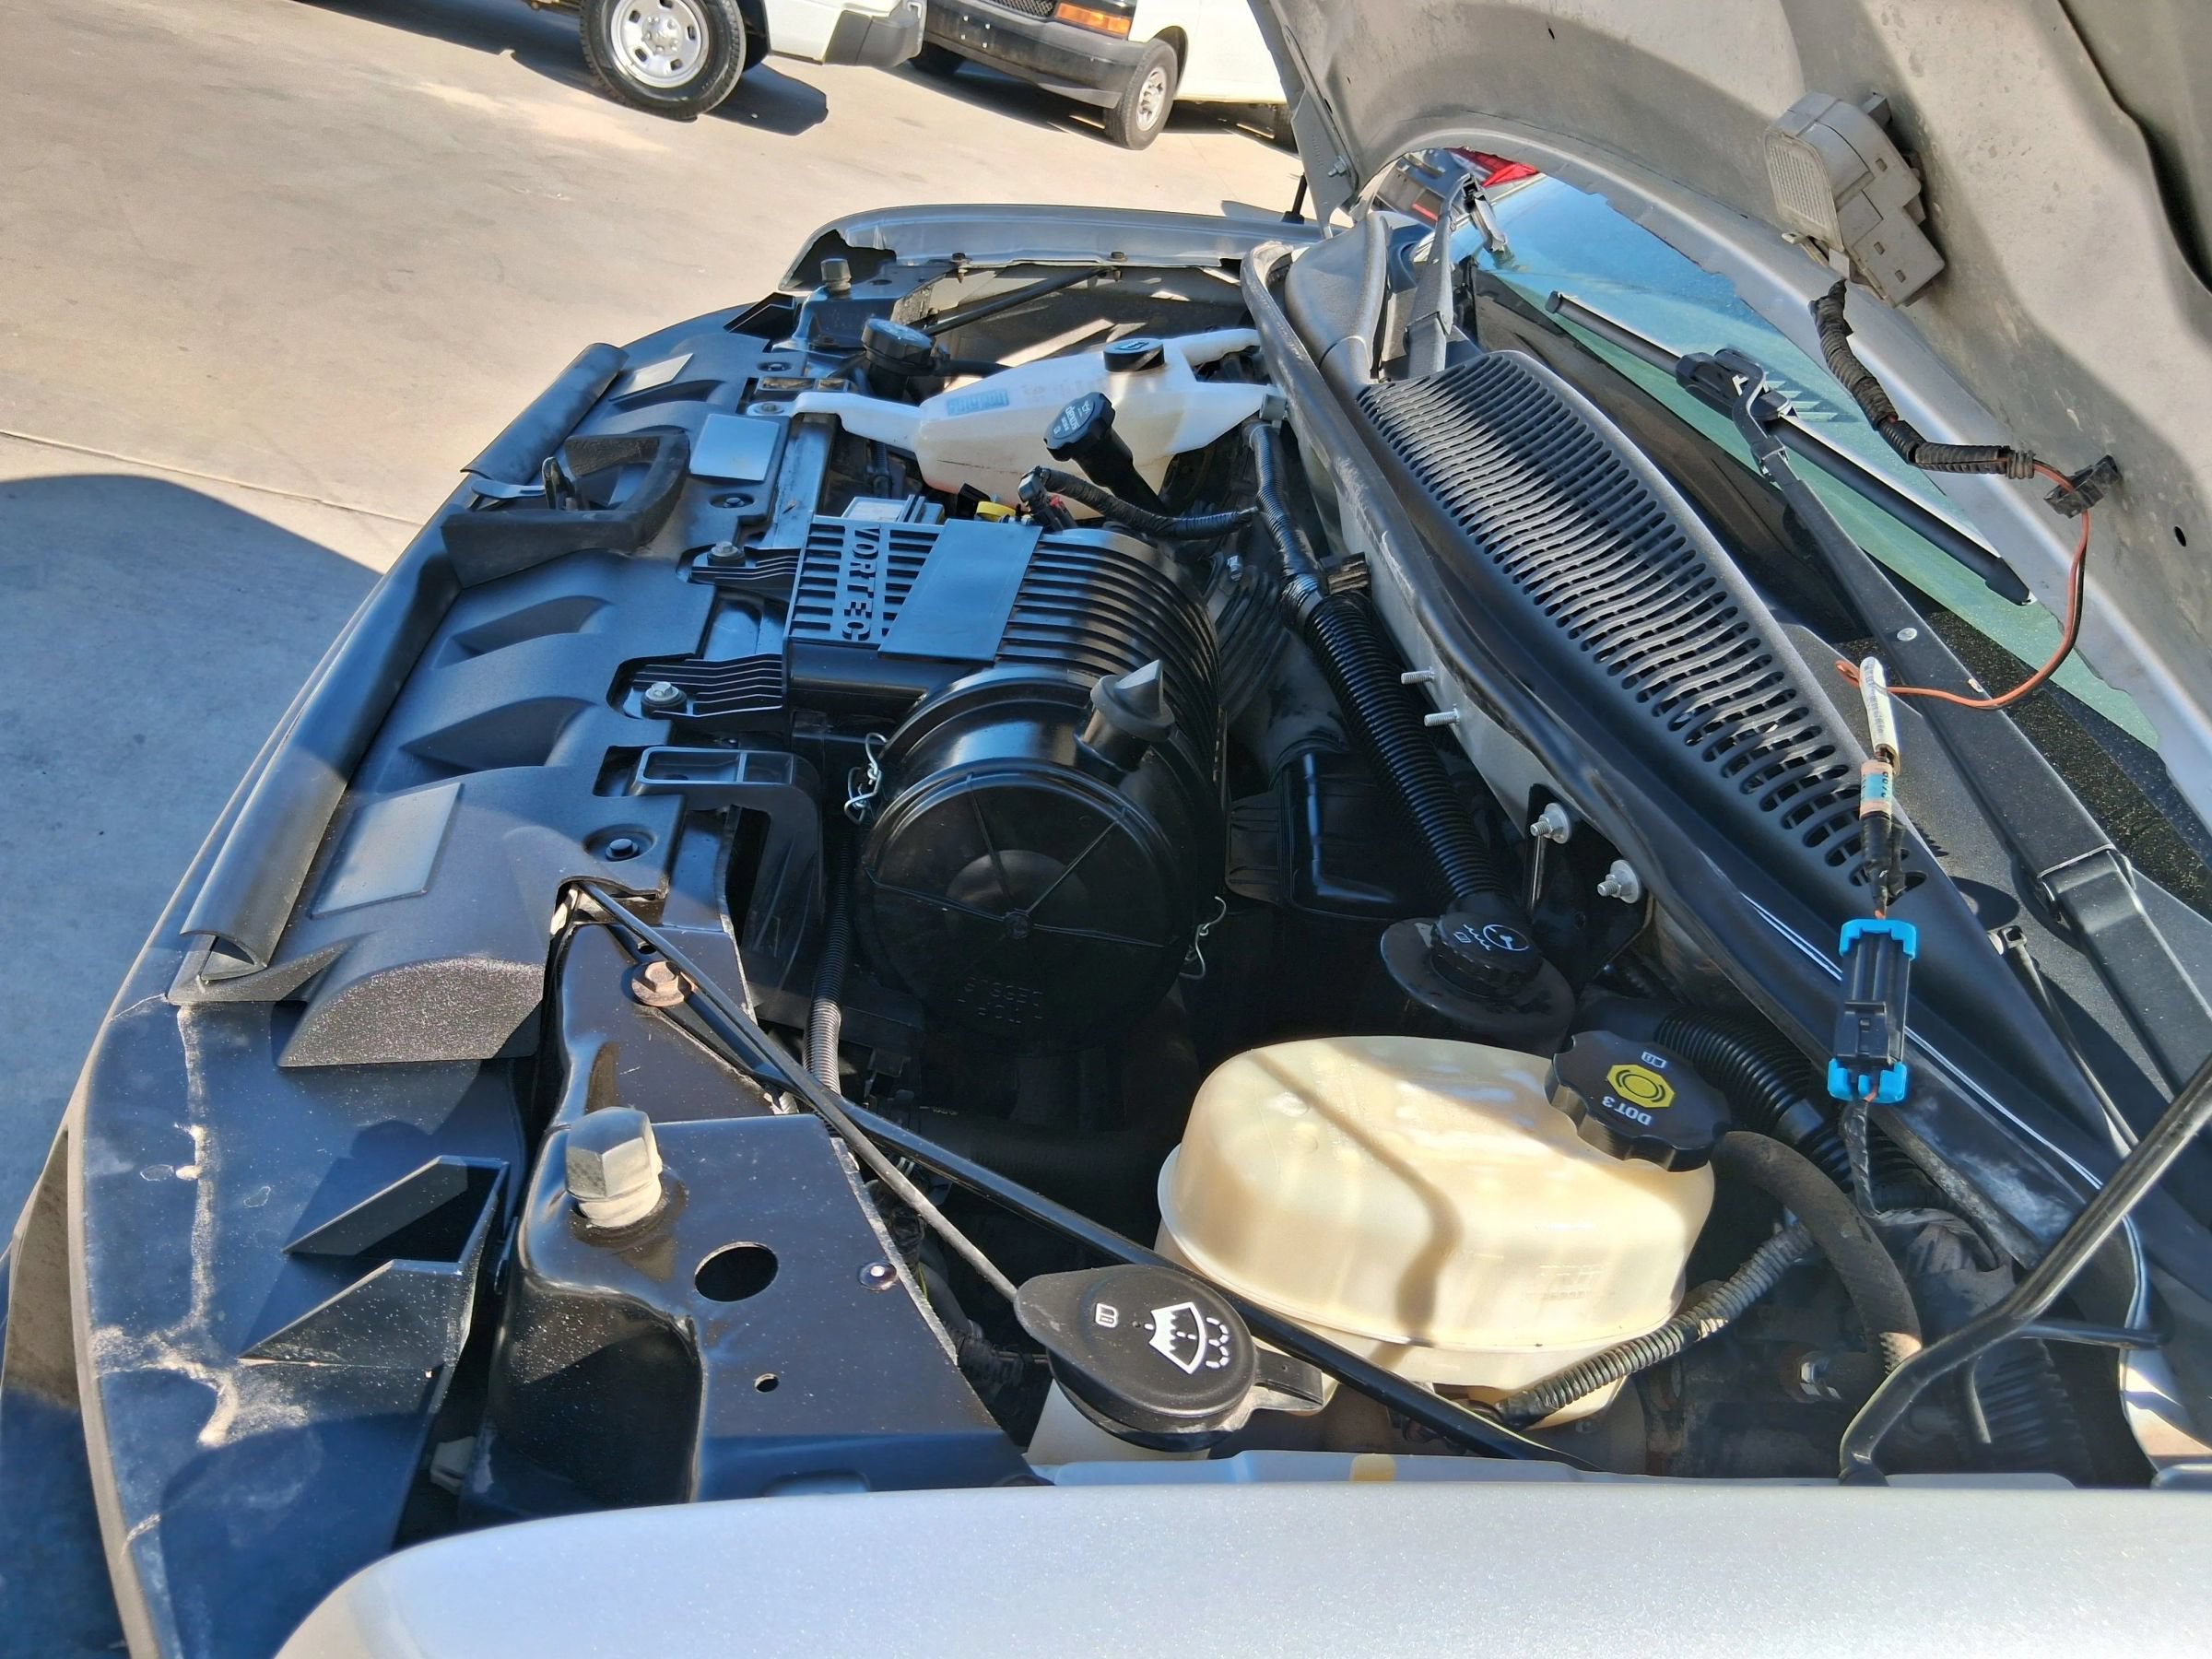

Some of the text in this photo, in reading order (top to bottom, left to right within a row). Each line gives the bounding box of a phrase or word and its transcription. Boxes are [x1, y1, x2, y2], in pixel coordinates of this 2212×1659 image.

[841, 527, 880, 641] VORTEC
[1603, 1096, 1652, 1125] DOT 3
